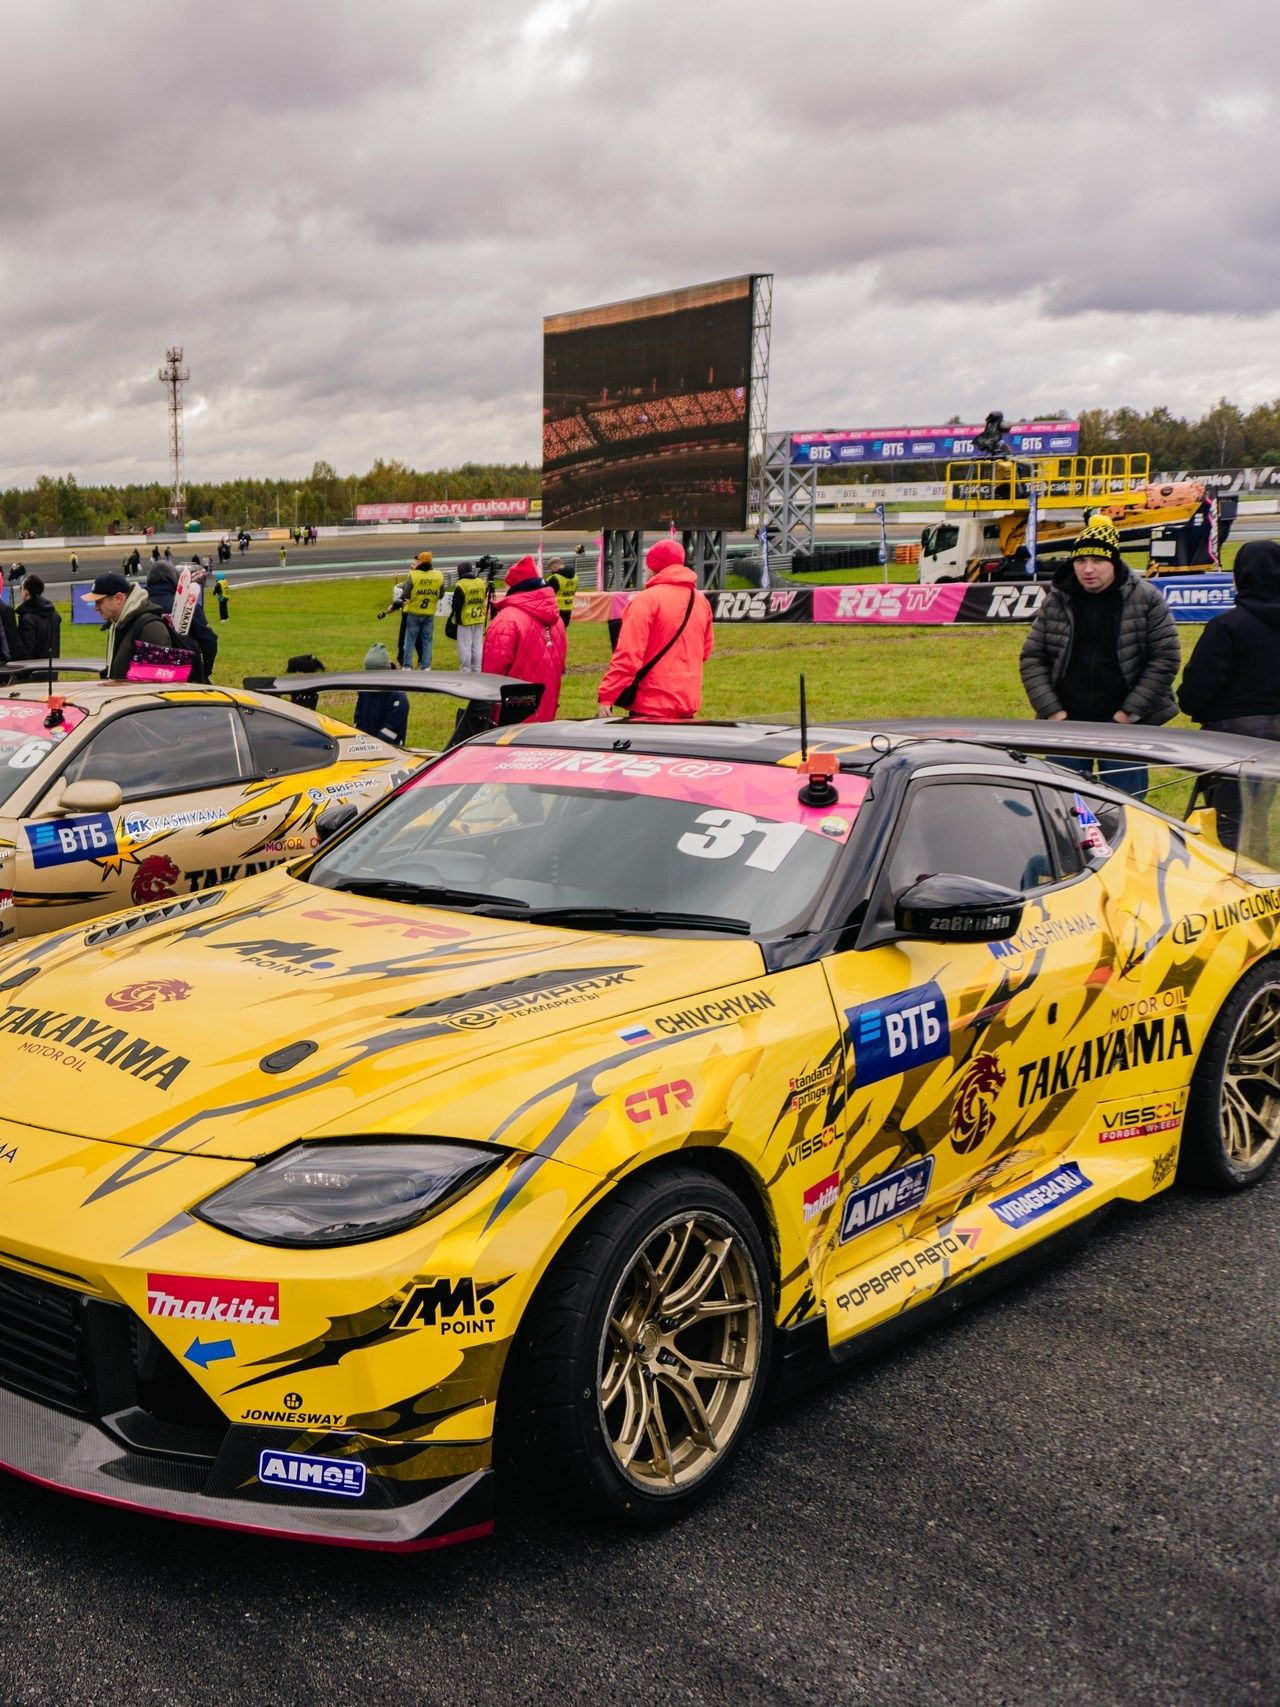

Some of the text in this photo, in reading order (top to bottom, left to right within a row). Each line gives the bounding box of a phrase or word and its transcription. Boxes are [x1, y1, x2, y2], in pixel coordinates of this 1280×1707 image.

[809, 446, 832, 460] ВТБ
[882, 442, 905, 456] ВТБ
[952, 439, 974, 453] ВТБ
[1021, 437, 1042, 450] ВТБ
[843, 490, 858, 498] ВТБ
[871, 488, 886, 497] ВТБ
[902, 487, 917, 496] ВТБ
[931, 486, 947, 496] ВТБ
[415, 502, 467, 514] auto.ru
[471, 499, 527, 513] auto.ru
[416, 589, 439, 597] MEDIA
[419, 598, 430, 609] 8
[714, 590, 798, 618] RDS TV
[835, 586, 942, 618] RDS TV
[986, 584, 1053, 619] RD
[1165, 588, 1236, 605] AIMOL
[470, 607, 484, 619] 62
[8, 741, 53, 768] 6
[550, 752, 733, 779] RDS GP
[326, 778, 375, 795] ВИРАЖ
[152, 807, 228, 831] KASHIYAMA
[57, 822, 109, 854] ВТБ
[264, 837, 306, 853] MOTOR
[676, 808, 807, 872] 31
[1213, 888, 1280, 931] LINGLONG
[300, 908, 472, 940] CTR
[1017, 911, 1101, 951] KASHIYAMA
[241, 956, 316, 977] POINT
[499, 972, 638, 1011] ВИРАЖ
[507, 992, 601, 1020] ТЕХМАРКЕТЫ
[655, 989, 777, 1035] CHIVCHYAN
[1110, 986, 1189, 1026] MOTOR OIL
[886, 1000, 942, 1059] ВТБ
[17, 1042, 87, 1073] MOTOR OIL
[1016, 1012, 1194, 1109] TAKAYAMA
[789, 1062, 832, 1091] Standard
[624, 1079, 695, 1124] CTR
[792, 1085, 827, 1110] Springs
[1102, 1101, 1184, 1129] VISSOL
[1101, 1117, 1181, 1141] FORGE WHEELS
[787, 1123, 845, 1168] VISSOL
[845, 1166, 929, 1234] AIMOL
[994, 1170, 1083, 1223] VIRAGE24.RU
[914, 1238, 959, 1271] АВТО
[440, 1318, 497, 1336] POINT
[240, 1408, 343, 1426] JONNESWAY
[263, 1457, 361, 1491] AIMOL
